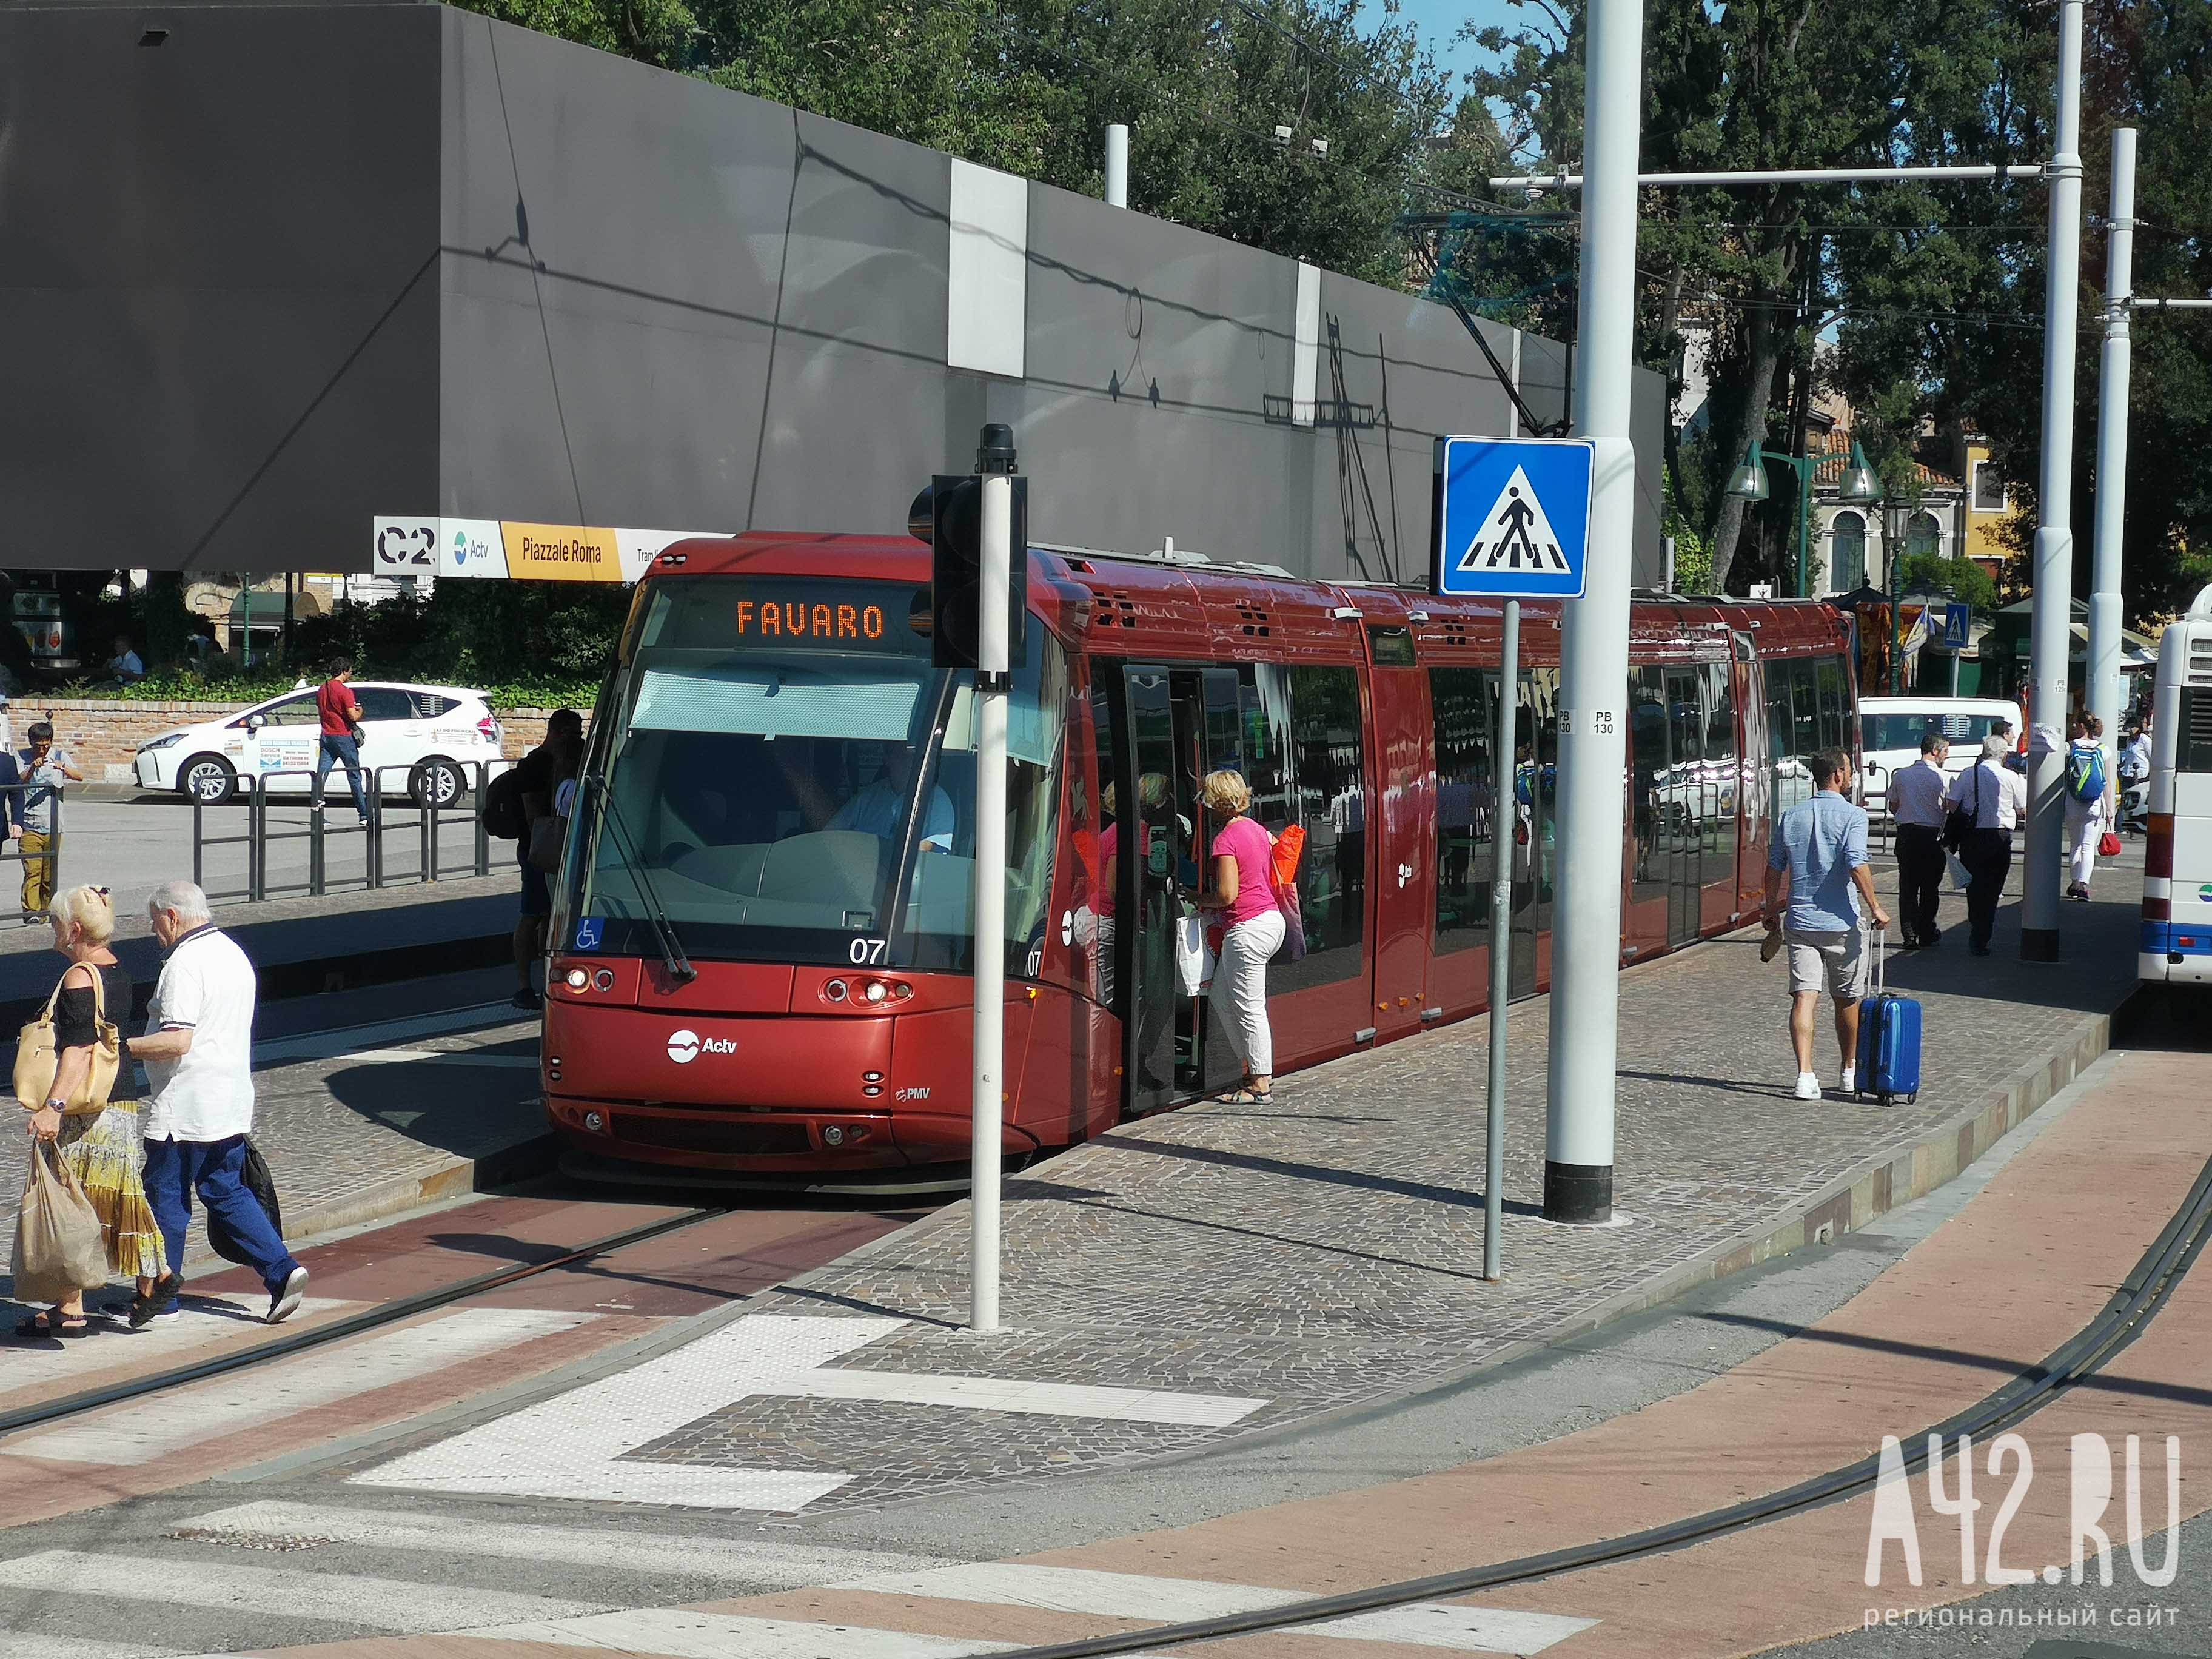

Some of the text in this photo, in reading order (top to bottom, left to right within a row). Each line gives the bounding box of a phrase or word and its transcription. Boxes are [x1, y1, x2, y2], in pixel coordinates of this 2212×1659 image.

[378, 526, 435, 565] C2
[470, 539, 489, 558] Actv
[523, 537, 602, 563] Piazzale Roma
[637, 548, 654, 562] Tram
[737, 601, 883, 638] FAVARO
[1560, 711, 1569, 721] PB
[1595, 712, 1612, 722] PB
[1594, 723, 1613, 734] 130
[849, 939, 886, 965] 07
[1027, 950, 1041, 977] 07
[701, 1037, 737, 1054] Actv
[907, 1088, 930, 1101] PMV
